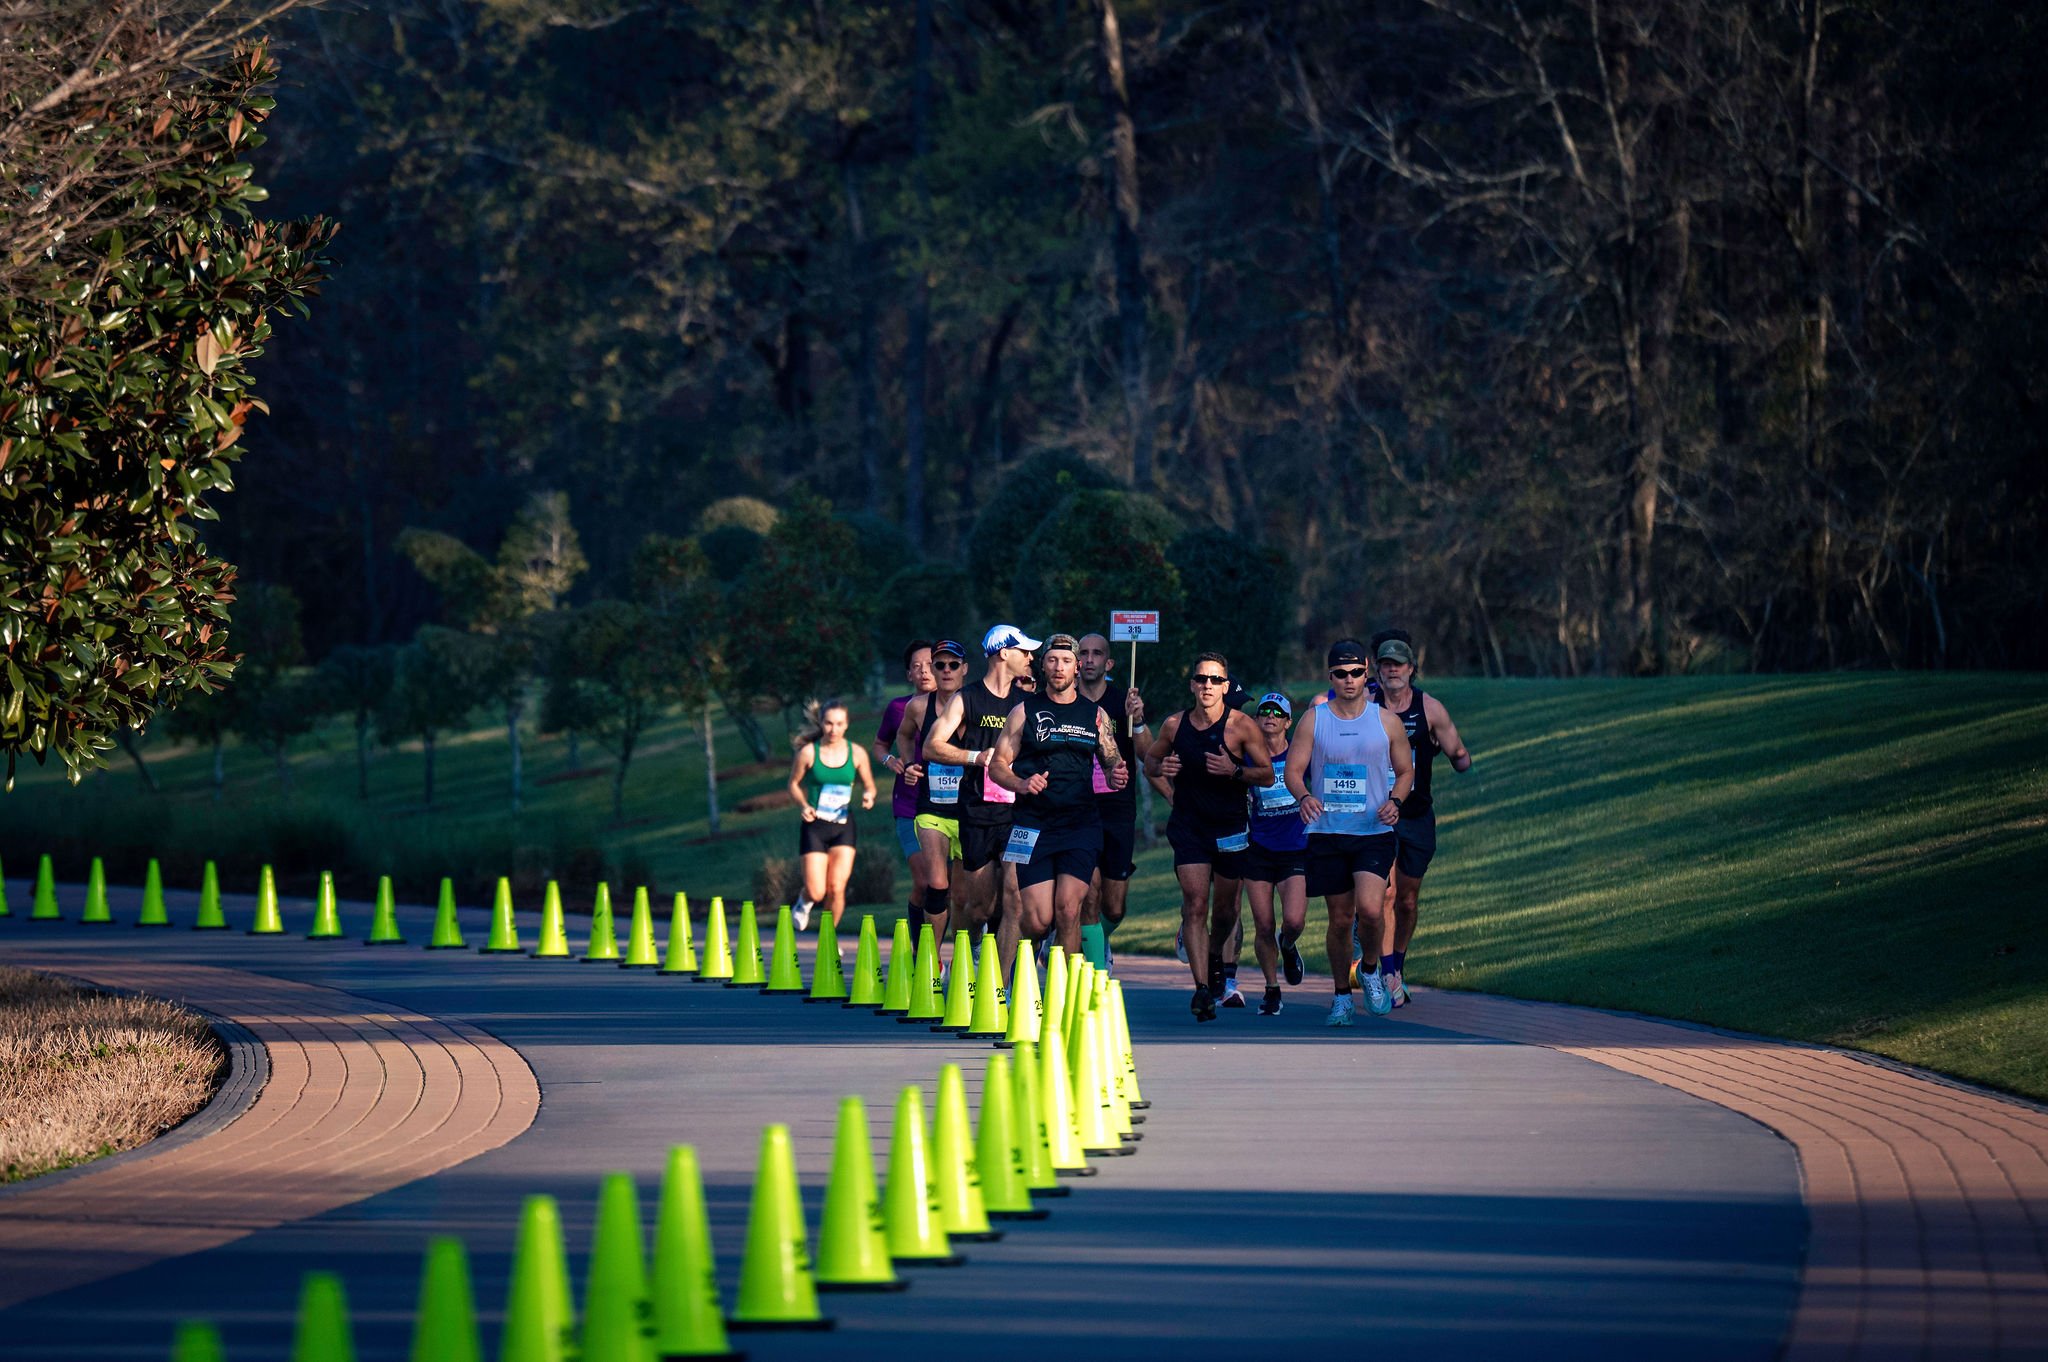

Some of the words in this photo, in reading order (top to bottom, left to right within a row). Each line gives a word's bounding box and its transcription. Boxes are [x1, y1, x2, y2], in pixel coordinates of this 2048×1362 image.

[1128, 625, 1142, 634] 3:15
[1050, 727, 1081, 735] GLADIATOR
[937, 776, 958, 785] 1514
[1333, 779, 1357, 789] 1419
[1013, 829, 1029, 840] 908
